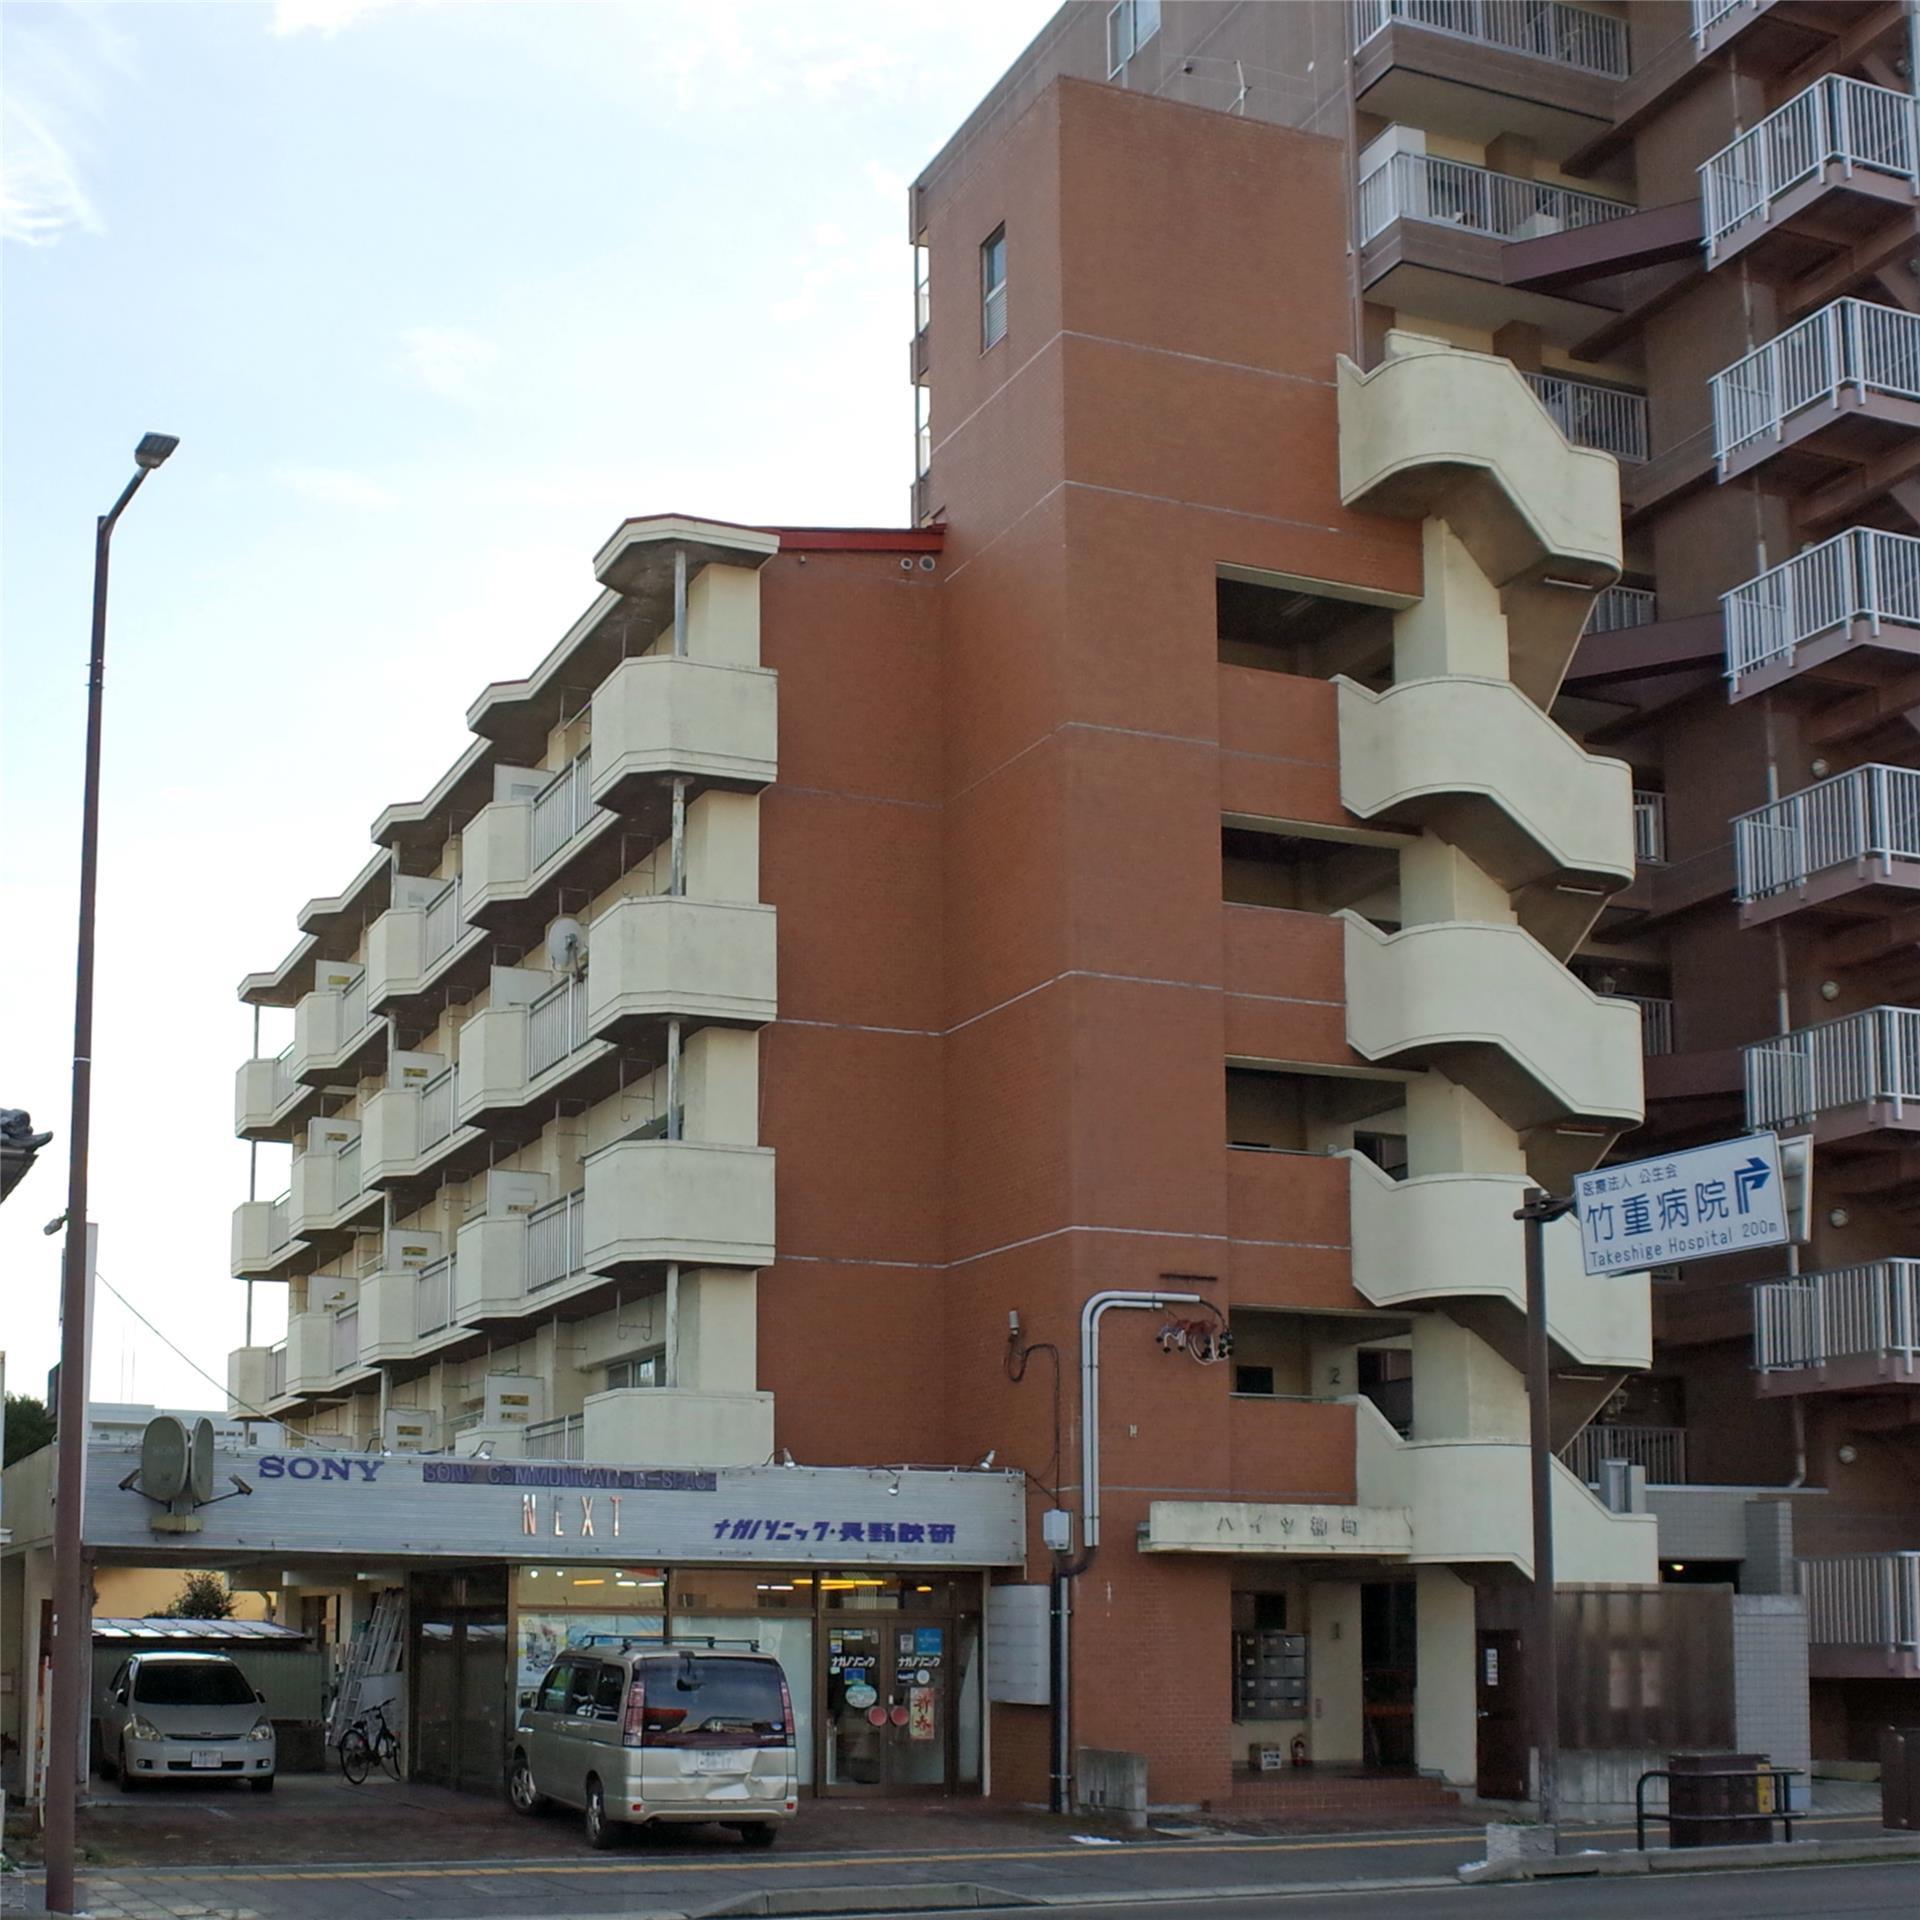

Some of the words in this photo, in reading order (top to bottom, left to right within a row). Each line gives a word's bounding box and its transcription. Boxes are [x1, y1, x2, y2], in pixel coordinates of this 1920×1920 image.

[1586, 1180, 1729, 1243] 竹重病院
[1591, 1244, 1662, 1267] Takeshige
[1669, 1232, 1733, 1252] Hospital
[1742, 1220, 1778, 1238] 200m
[258, 1456, 385, 1482] SONY
